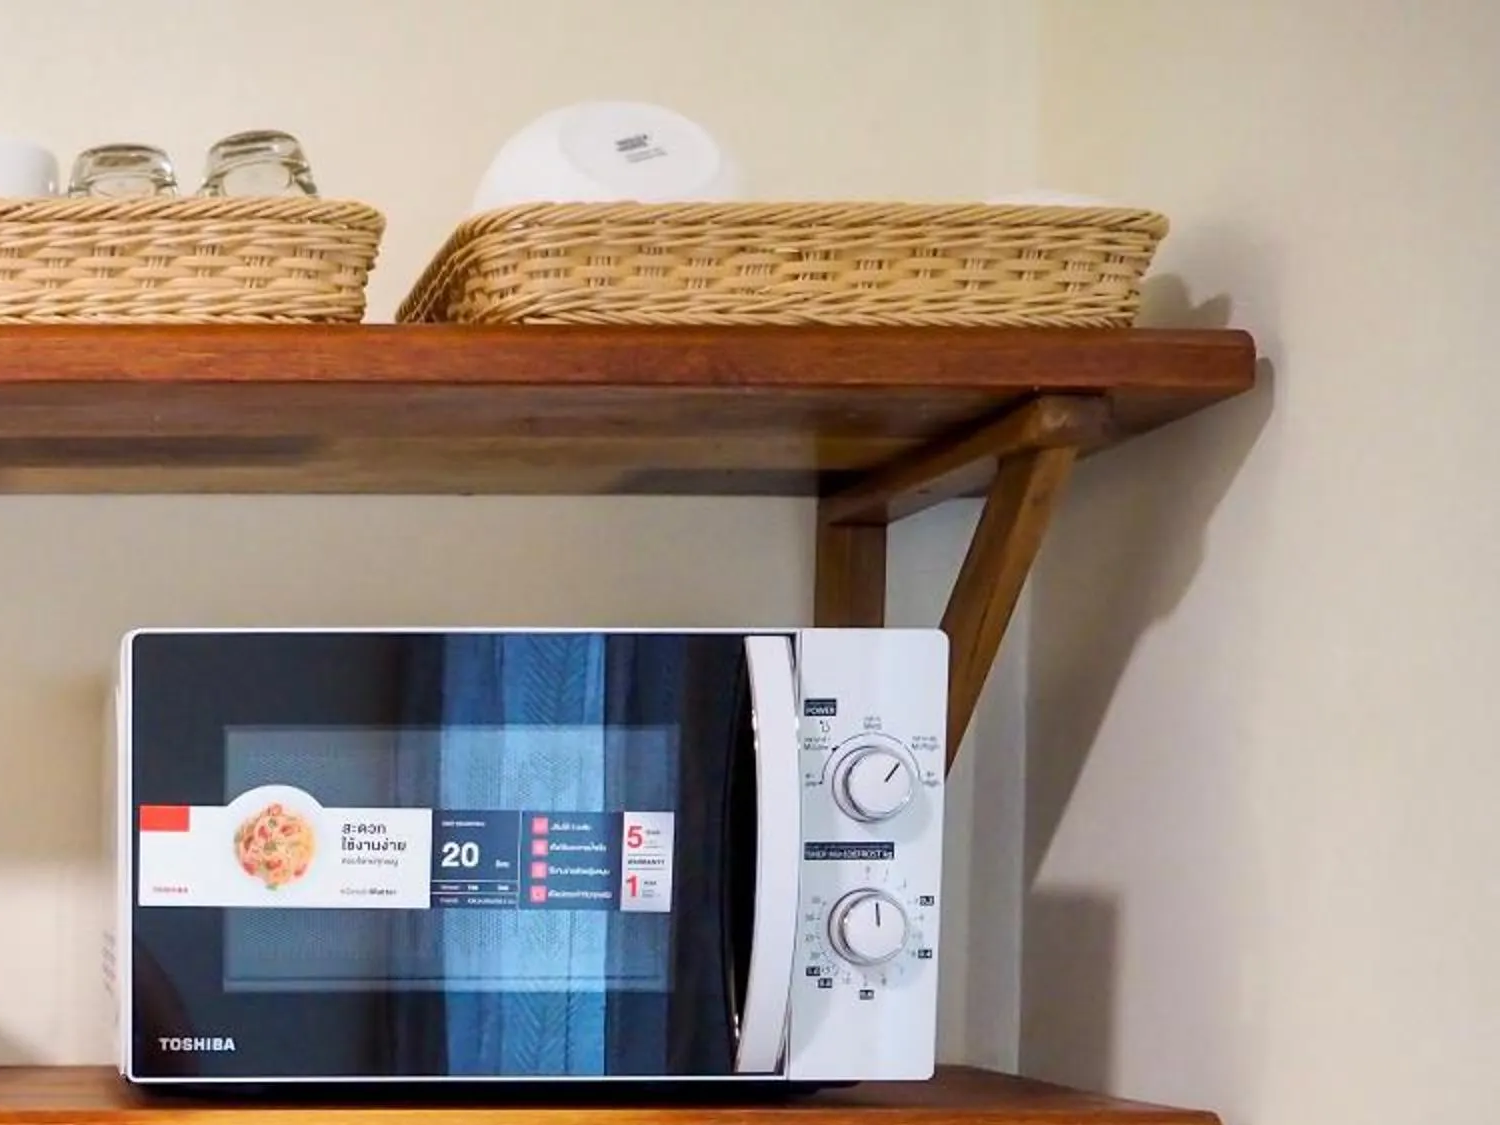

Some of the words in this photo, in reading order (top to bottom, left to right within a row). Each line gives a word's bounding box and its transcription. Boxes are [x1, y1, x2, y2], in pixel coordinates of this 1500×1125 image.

[341, 823, 387, 835] สะดวก
[627, 825, 643, 849] 5
[341, 835, 407, 851] ใช้งานง่าย
[441, 841, 479, 868] 20
[626, 875, 638, 897] 1
[158, 1037, 236, 1051] TOSHIBA
